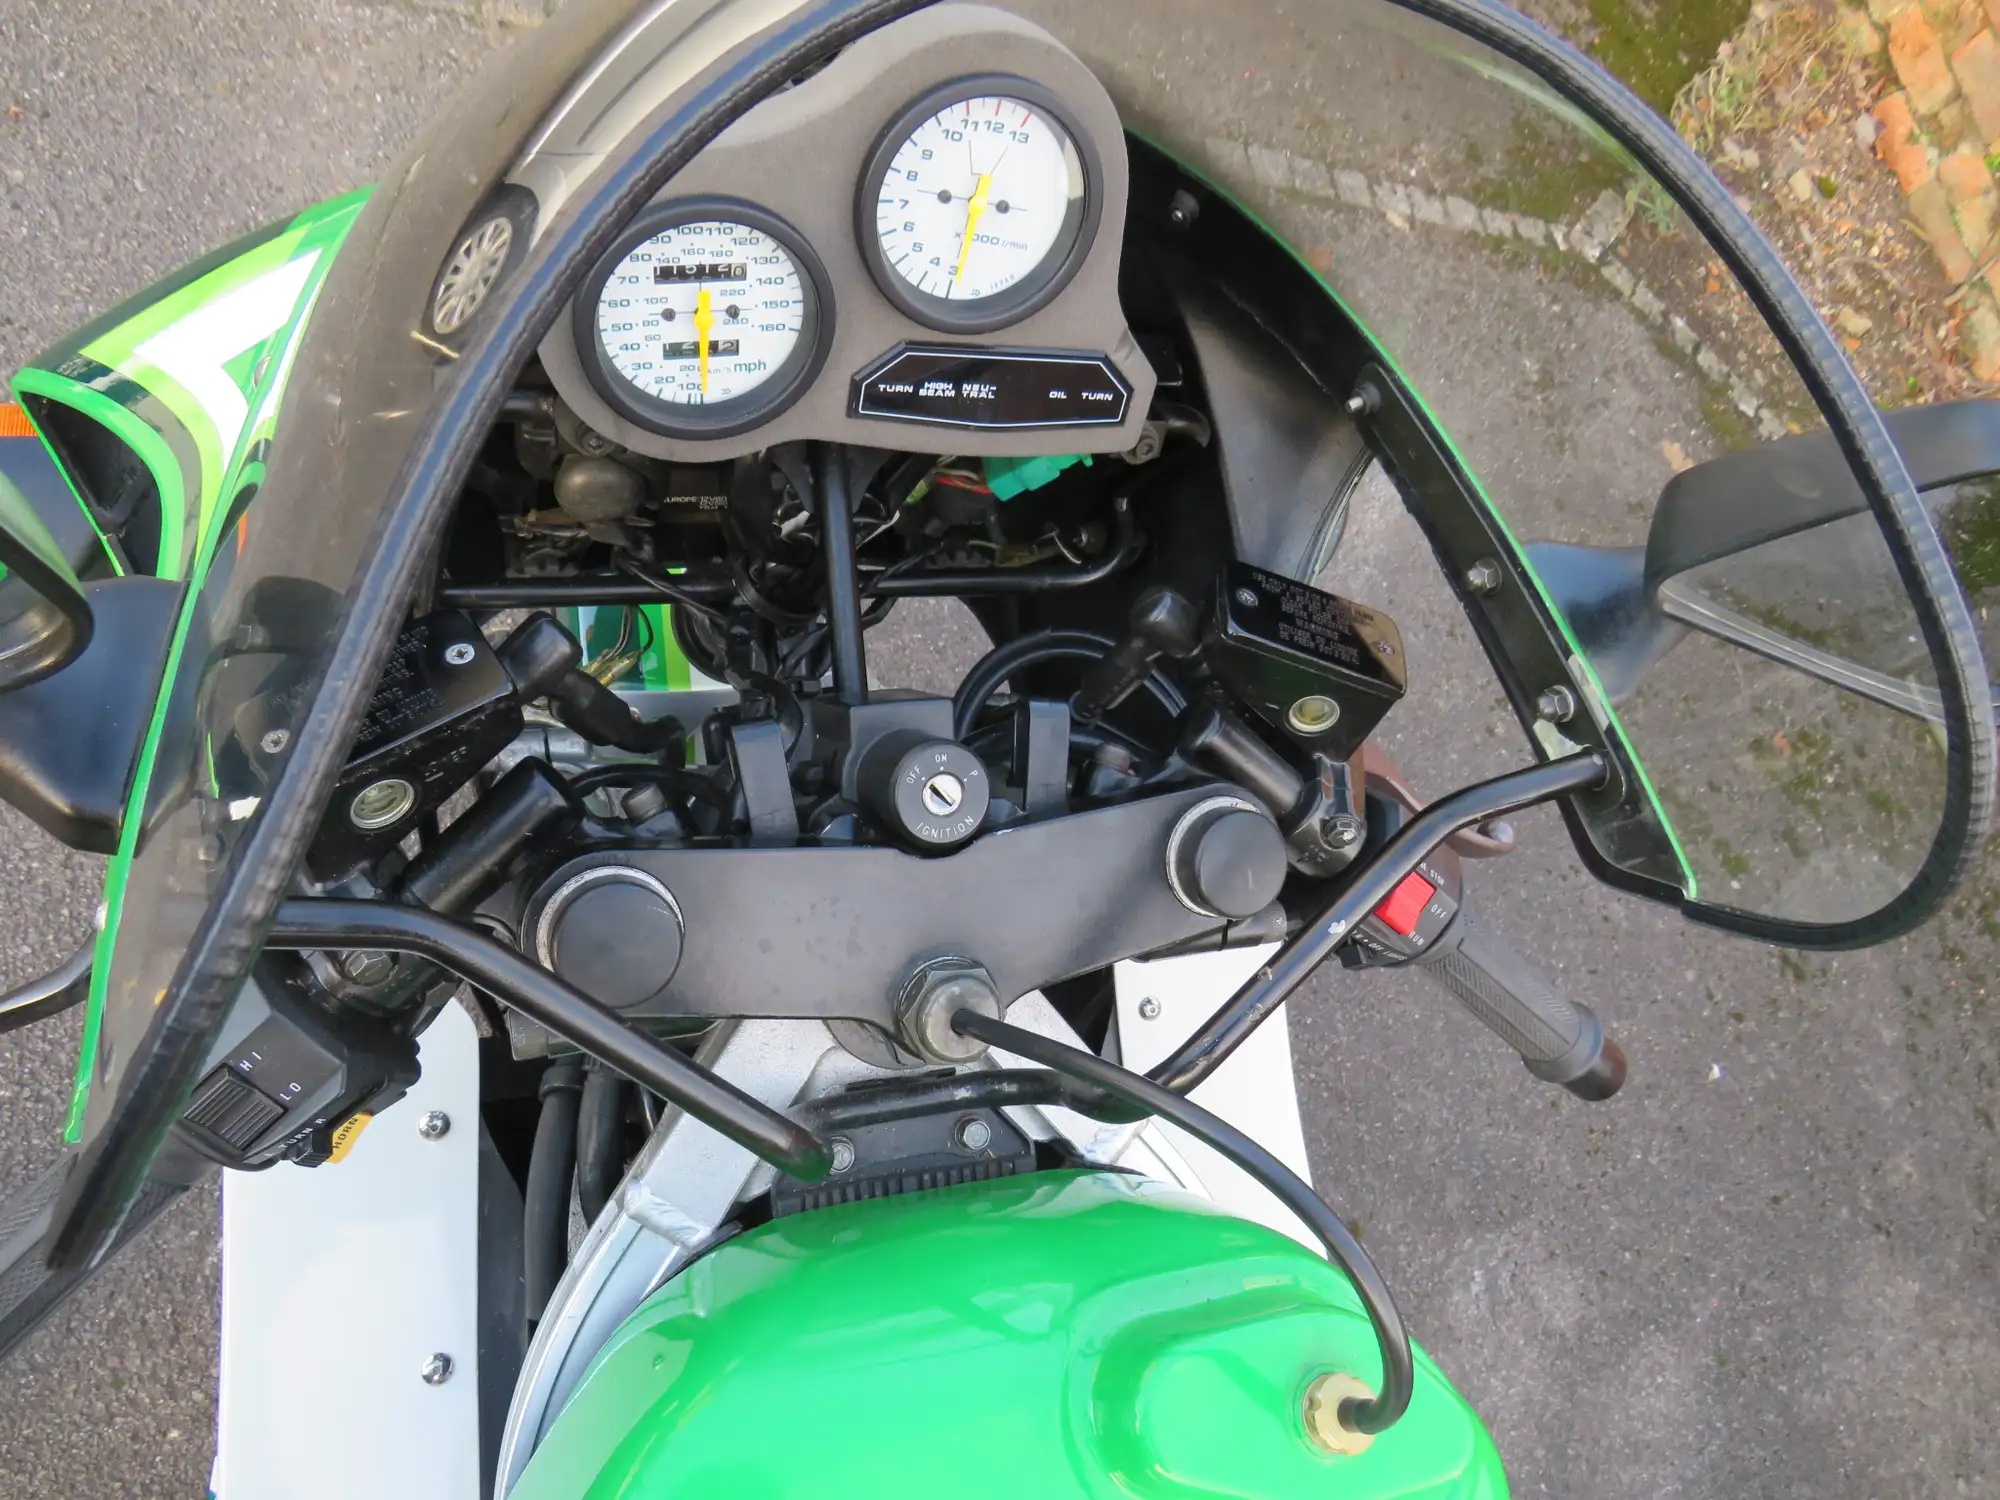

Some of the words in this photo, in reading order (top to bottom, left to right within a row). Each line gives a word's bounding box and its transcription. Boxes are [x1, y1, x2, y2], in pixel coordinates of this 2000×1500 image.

[961, 119, 979, 131] 11
[984, 120, 1005, 134] 12
[942, 129, 963, 142] 10
[1009, 131, 1030, 144] 13
[921, 149, 933, 160] 9
[906, 170, 918, 181] 8
[899, 199, 909, 209] 7
[676, 226, 703, 235] 100
[705, 226, 733, 236] 110
[903, 221, 915, 232] 6
[731, 237, 760, 246] 120
[912, 242, 924, 252] 5
[629, 253, 652, 262] 80
[751, 256, 780, 265] 130
[929, 256, 941, 267] 4
[617, 276, 639, 285] 70
[755, 277, 784, 286] 140
[720, 288, 746, 297] 220
[608, 299, 630, 308] 60
[761, 300, 789, 309] 150
[611, 323, 633, 332] 50
[758, 323, 786, 332] 160
[619, 342, 640, 352] 40
[631, 362, 653, 371] 30
[734, 359, 767, 373] mph
[654, 376, 675, 384] 20
[878, 384, 914, 393] TURN
[924, 382, 953, 390] HIGH
[962, 383, 997, 391] NEU-
[919, 388, 956, 397] BEAM
[962, 390, 995, 399] TRAL
[1049, 391, 1067, 399] OIL
[1081, 392, 1113, 401] TURN
[935, 754, 947, 763] ON
[906, 765, 921, 784] OFF
[969, 769, 979, 777] P
[916, 815, 974, 838] IGNITION
[1430, 904, 1447, 919] OFF
[1408, 931, 1425, 946] RUN
[239, 1051, 262, 1072] HI
[279, 1082, 302, 1101] LO
[332, 1116, 359, 1150] HORN
[278, 1127, 314, 1149] TURN
